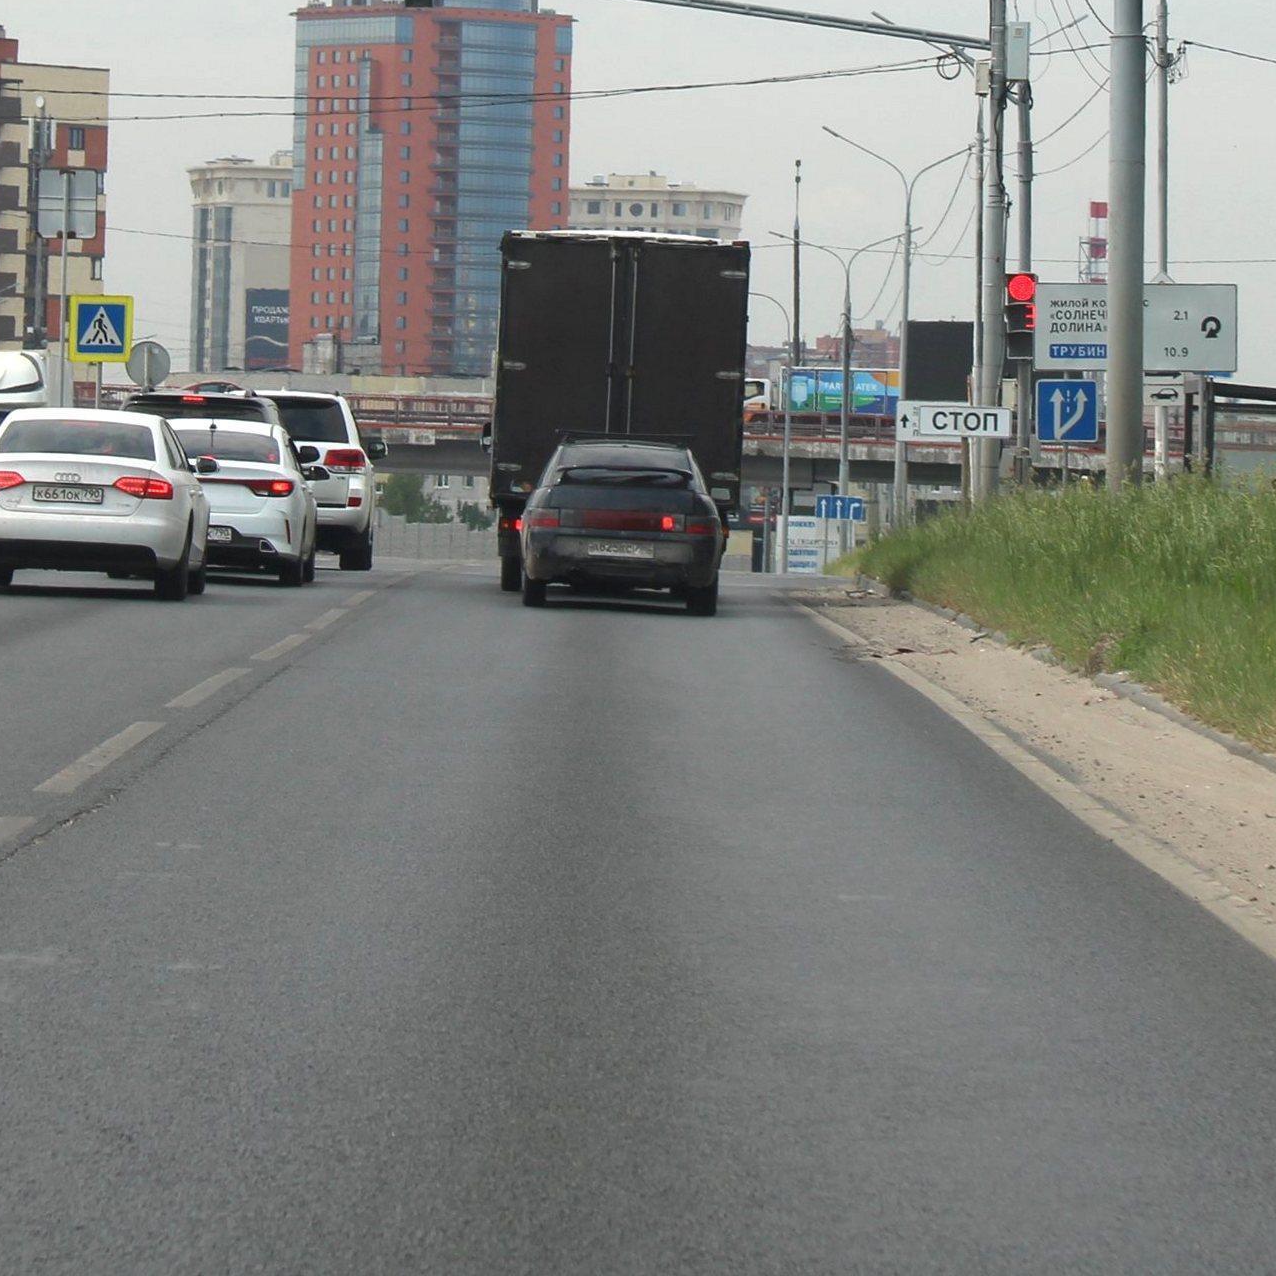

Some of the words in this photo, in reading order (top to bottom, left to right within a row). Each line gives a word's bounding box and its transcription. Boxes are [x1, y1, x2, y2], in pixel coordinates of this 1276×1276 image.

[1173, 310, 1189, 321] 2.1
[1052, 345, 1106, 357] ТРУБИН
[1163, 346, 1190, 358] 10.9
[932, 411, 999, 432] СТОП
[83, 488, 101, 499] 790
